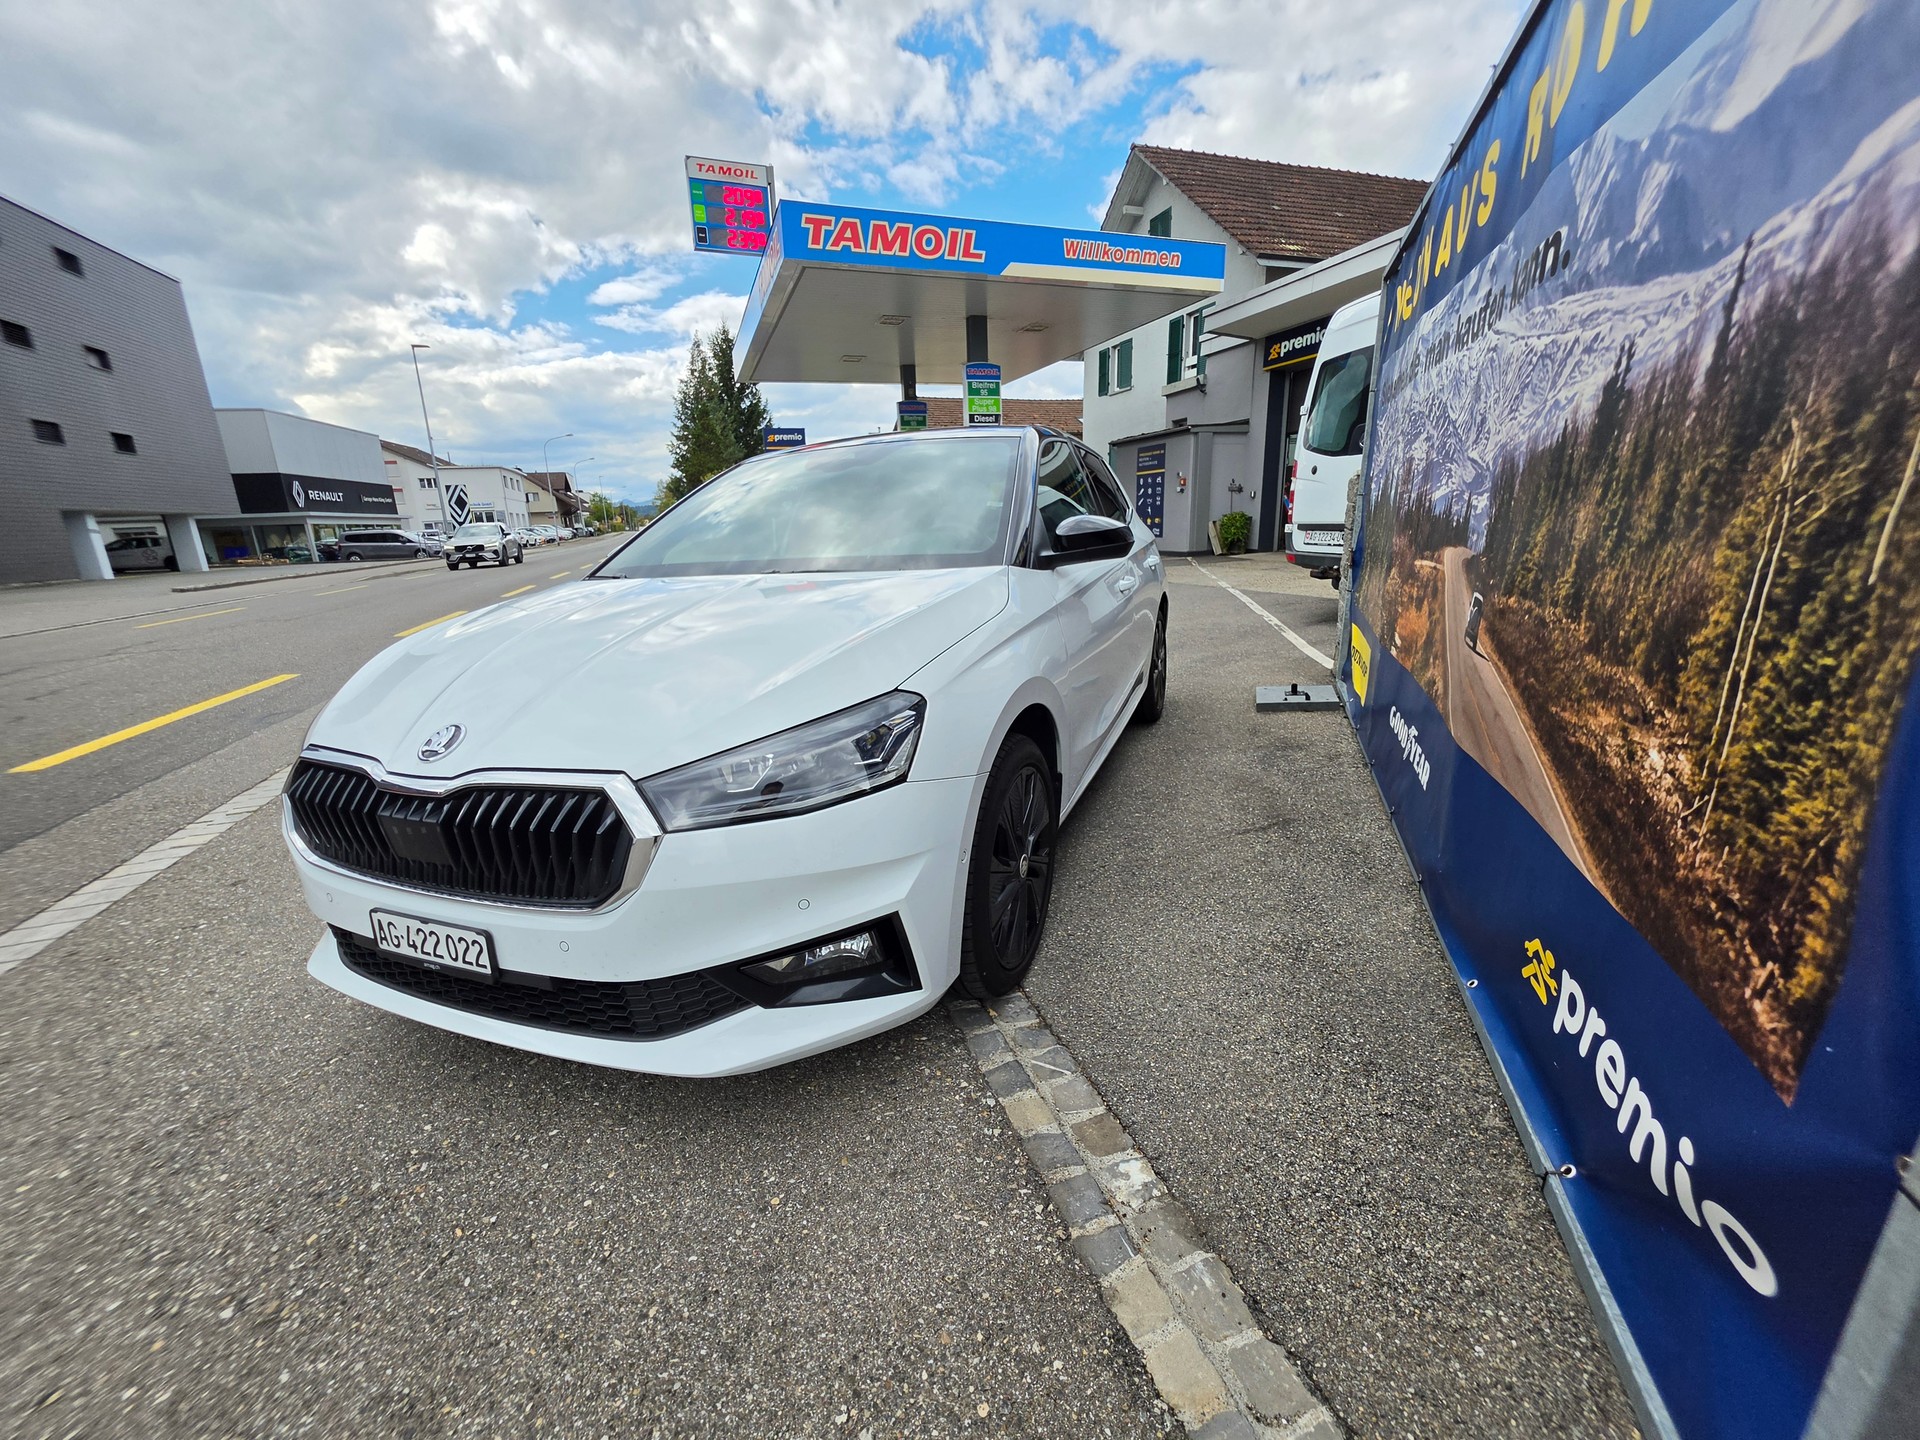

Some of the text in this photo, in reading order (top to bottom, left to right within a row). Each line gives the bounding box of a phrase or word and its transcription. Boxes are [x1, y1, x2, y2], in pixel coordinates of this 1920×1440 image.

[696, 163, 758, 180] TAMOIL
[801, 213, 986, 263] TAMOIL
[1063, 238, 1182, 268] Willkommen
[1455, 284, 1507, 352] kaufen
[967, 368, 1000, 376] TAMOIL
[971, 381, 996, 389] Bleifrei
[974, 398, 994, 407] Super
[775, 433, 803, 442] premio
[308, 490, 344, 502] RENAULT
[1553, 969, 1778, 1298] premio
